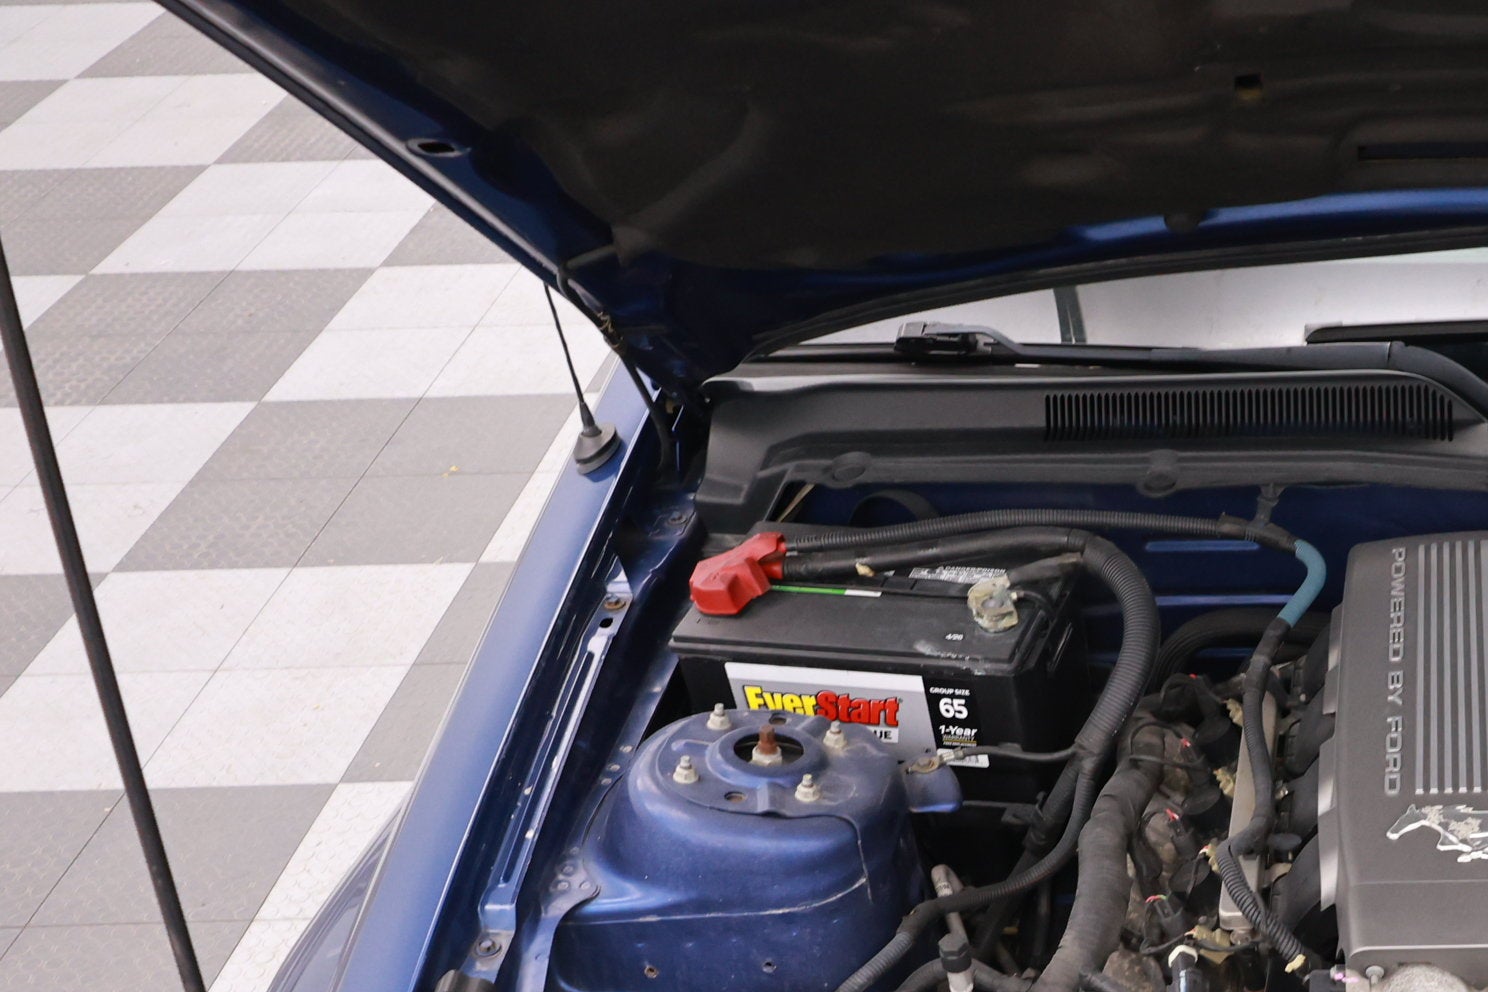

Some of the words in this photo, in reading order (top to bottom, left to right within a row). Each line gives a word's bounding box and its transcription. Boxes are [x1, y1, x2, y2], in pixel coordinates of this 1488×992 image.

[1387, 547, 1406, 663] POWERED
[743, 684, 900, 728] EverStart
[929, 686, 954, 695] GROUP
[954, 687, 970, 696] SIZE
[1387, 670, 1404, 706] BY
[938, 697, 969, 720] 65
[938, 724, 978, 737] 1-Year
[1384, 715, 1402, 796] FORD
